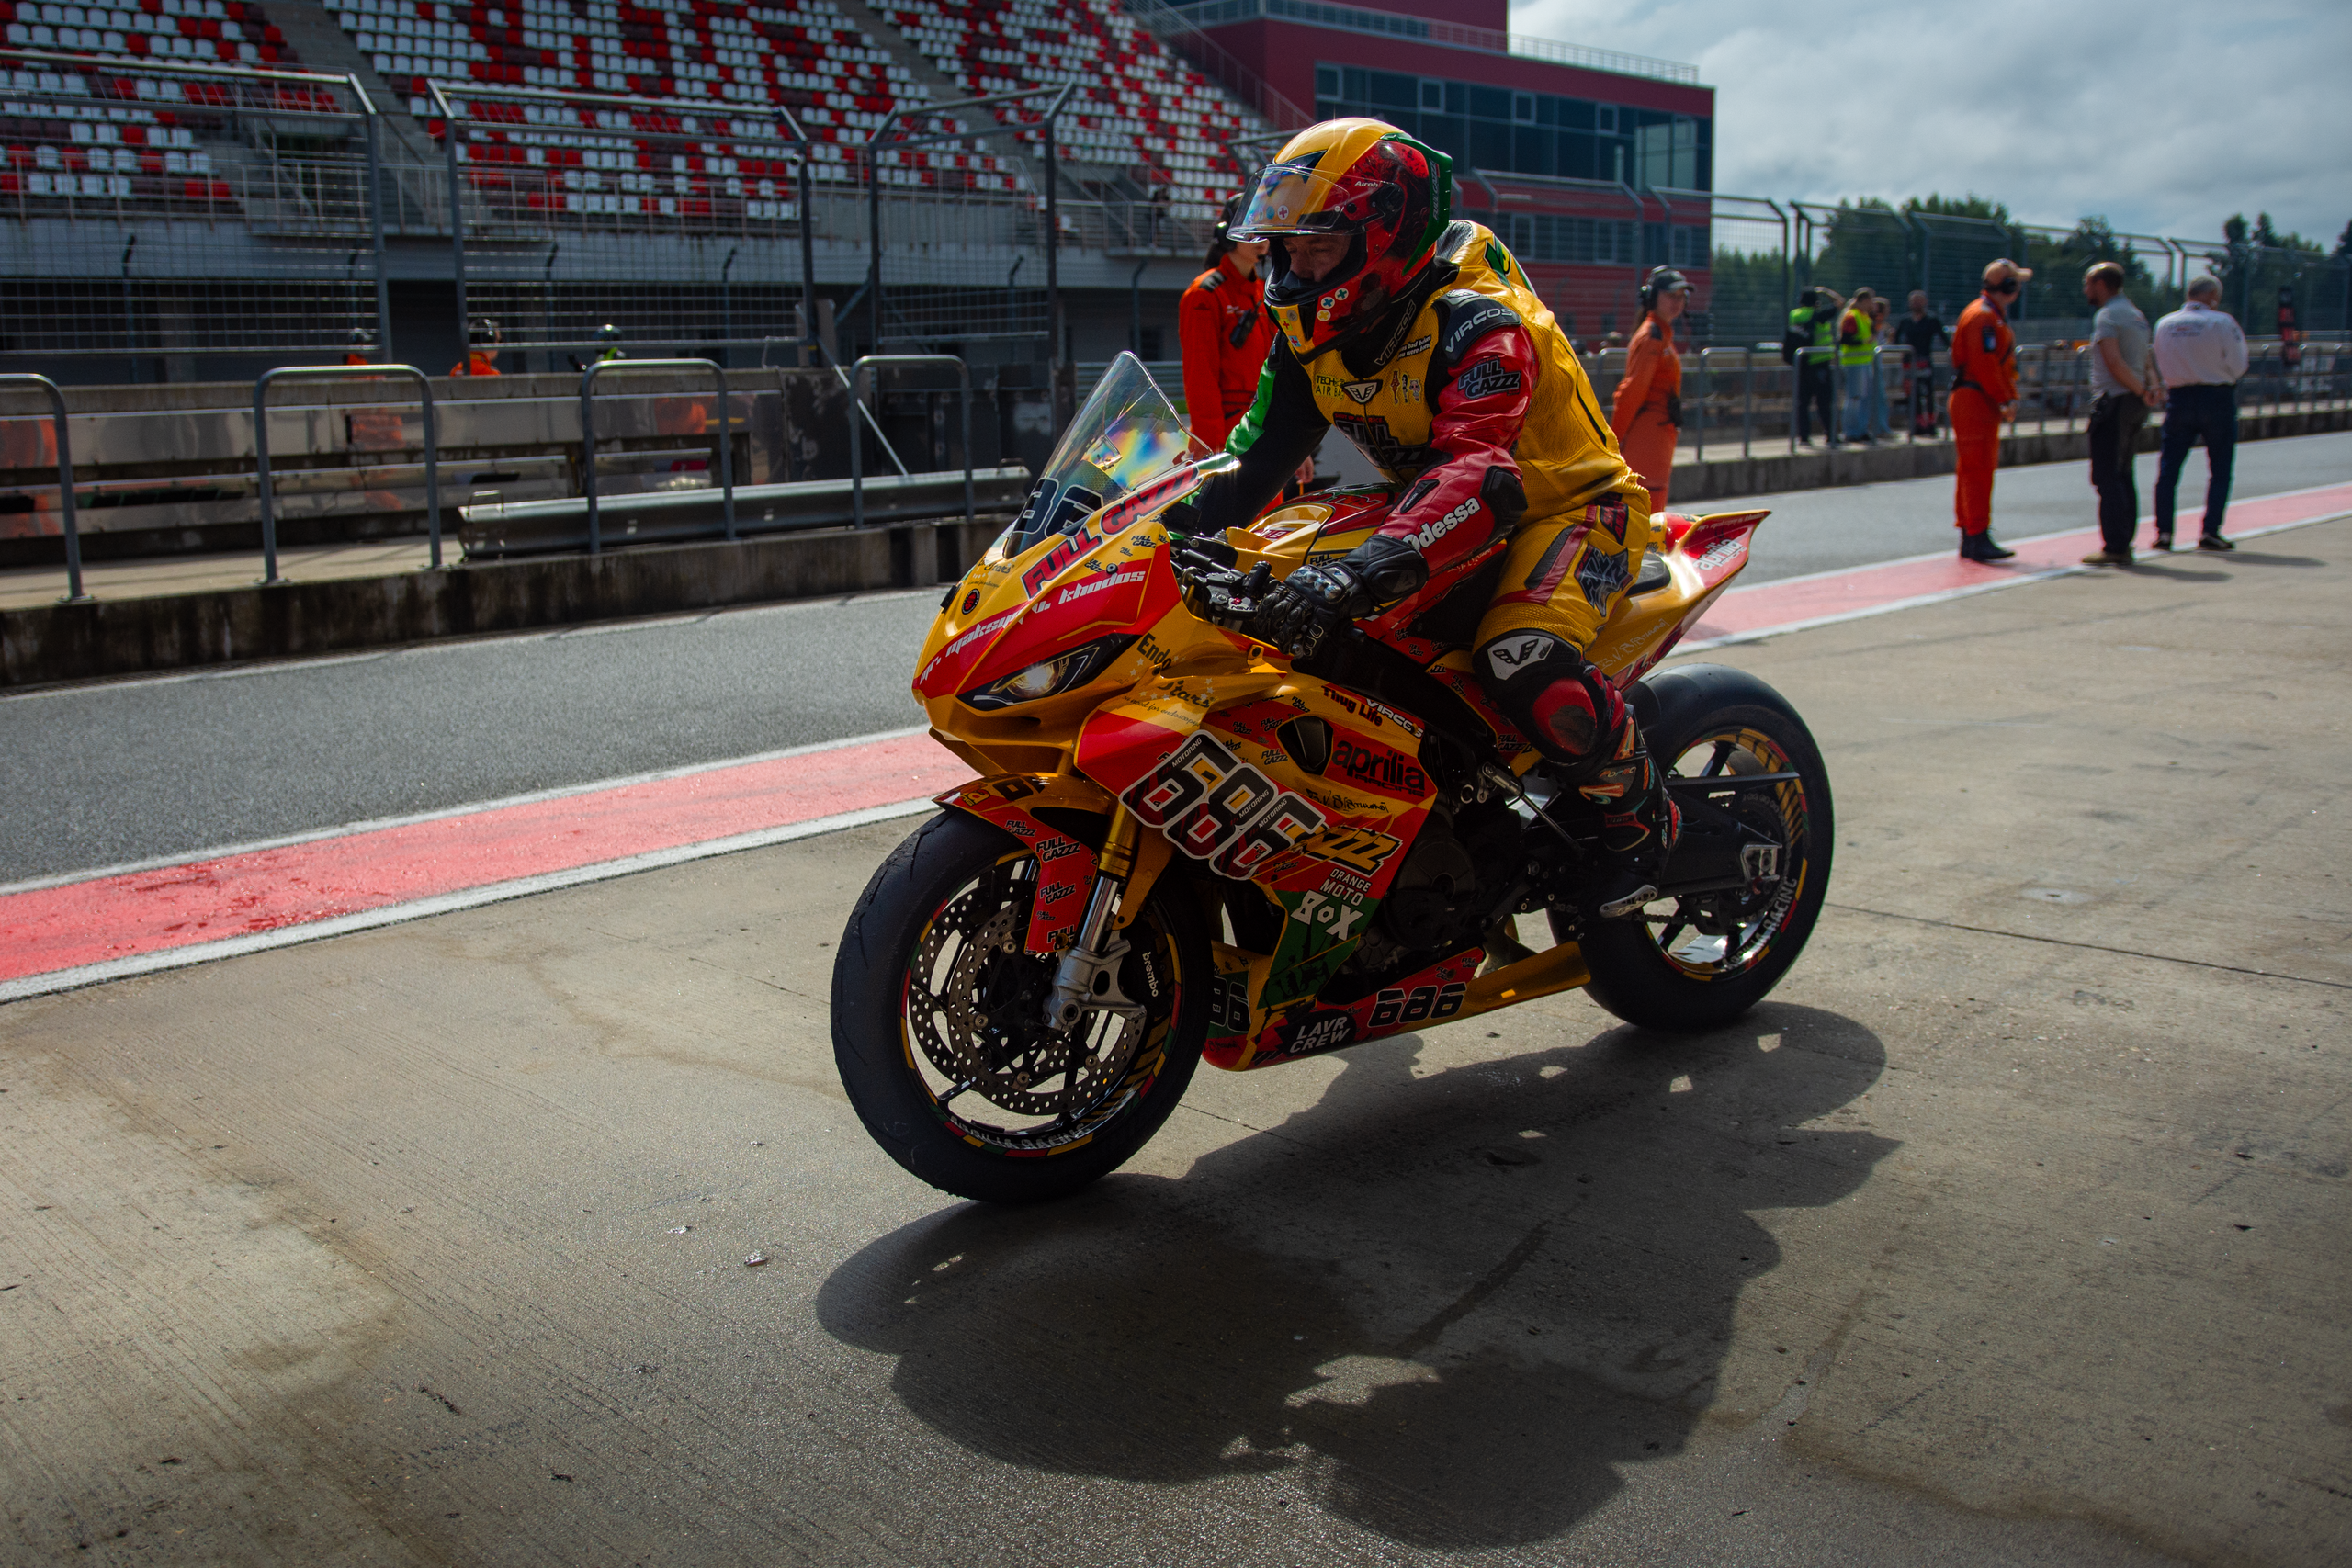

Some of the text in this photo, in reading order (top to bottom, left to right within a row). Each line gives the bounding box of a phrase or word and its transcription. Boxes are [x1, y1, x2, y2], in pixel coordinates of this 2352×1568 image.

[1374, 299, 1417, 366] VIRCOS
[1445, 309, 1513, 353] VIRCOS
[1458, 359, 1504, 390] FULL
[1466, 372, 1521, 398] GAZZZ
[1021, 462, 1204, 600] FULL GAZZZ
[1402, 497, 1482, 551] Odessa
[1310, 554, 1333, 565] FULL
[1692, 537, 1743, 570] aprilia
[1058, 571, 1147, 605] khodos
[1136, 633, 1172, 671] Endo
[1452, 674, 1466, 689] FULL
[1148, 702, 1160, 712] for
[1292, 696, 1306, 705] FULL
[1321, 685, 1383, 727] Thug Life
[1261, 716, 1275, 728] FULL
[1366, 698, 1424, 739] VIRCOS
[1498, 733, 1518, 743] FULL
[1171, 738, 1202, 768] MOTORING
[1261, 748, 1281, 760] FULL
[1264, 754, 1289, 765] GAZZZ
[1332, 740, 1425, 790] aprilia
[1118, 729, 1327, 881] 686
[1238, 789, 1270, 818] MOTORING
[1258, 798, 1288, 829] MOTORING
[1004, 819, 1027, 828] FULL
[1035, 835, 1066, 853] FULL
[1041, 841, 1080, 863] GAZZZ
[1039, 880, 1063, 900] FULL
[1045, 883, 1076, 905] GAZZZ
[1319, 878, 1365, 907] MOTO
[1329, 867, 1372, 893] ORANGE
[1046, 924, 1075, 944] FULL
[1141, 952, 1159, 998] brembo
[1367, 981, 1467, 1028] 686
[1289, 1027, 1350, 1054] CREW
[1295, 1016, 1348, 1041] LAVR
